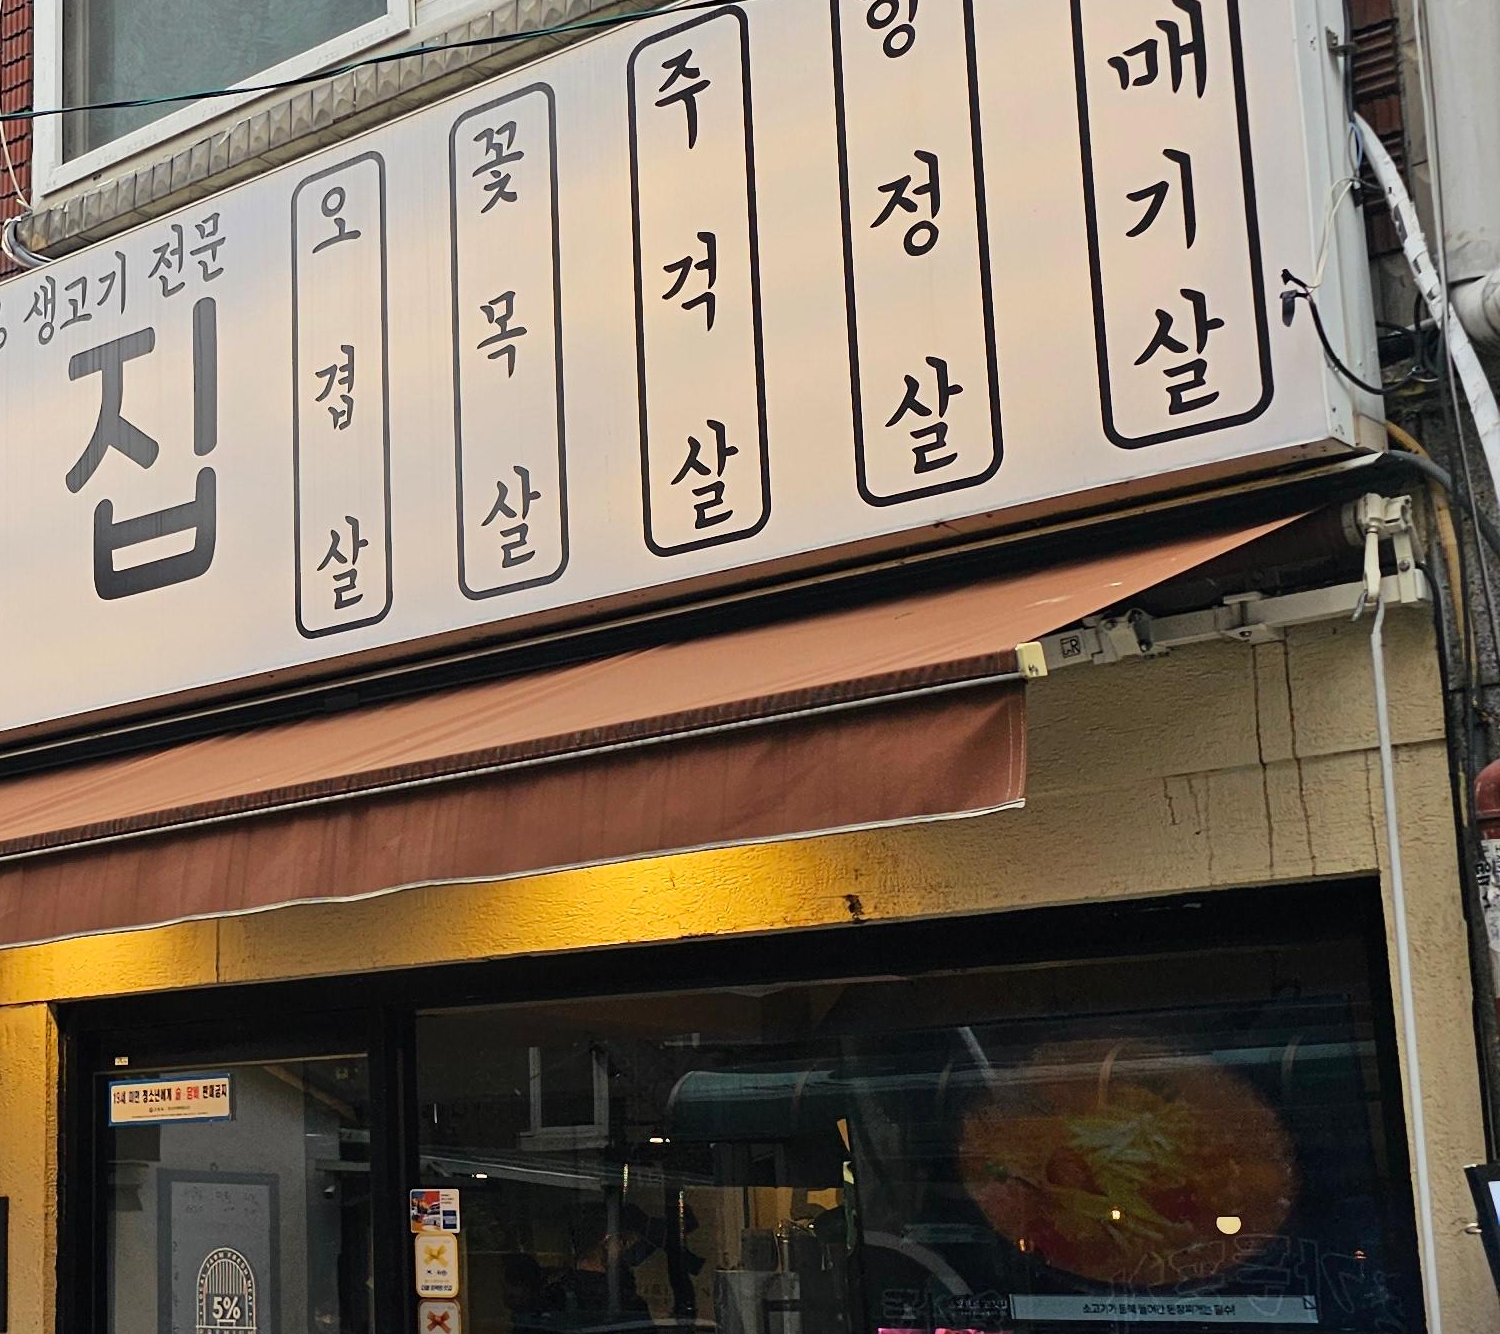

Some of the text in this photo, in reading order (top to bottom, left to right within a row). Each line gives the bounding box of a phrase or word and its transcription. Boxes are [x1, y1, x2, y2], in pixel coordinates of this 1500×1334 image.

[23, 250, 127, 346] 생고기
[148, 212, 227, 299] 전문
[311, 184, 370, 610] 오겹살
[472, 120, 542, 566] 꽃목살
[654, 58, 739, 531] 주걱살
[212, 1295, 241, 1320] 5%
